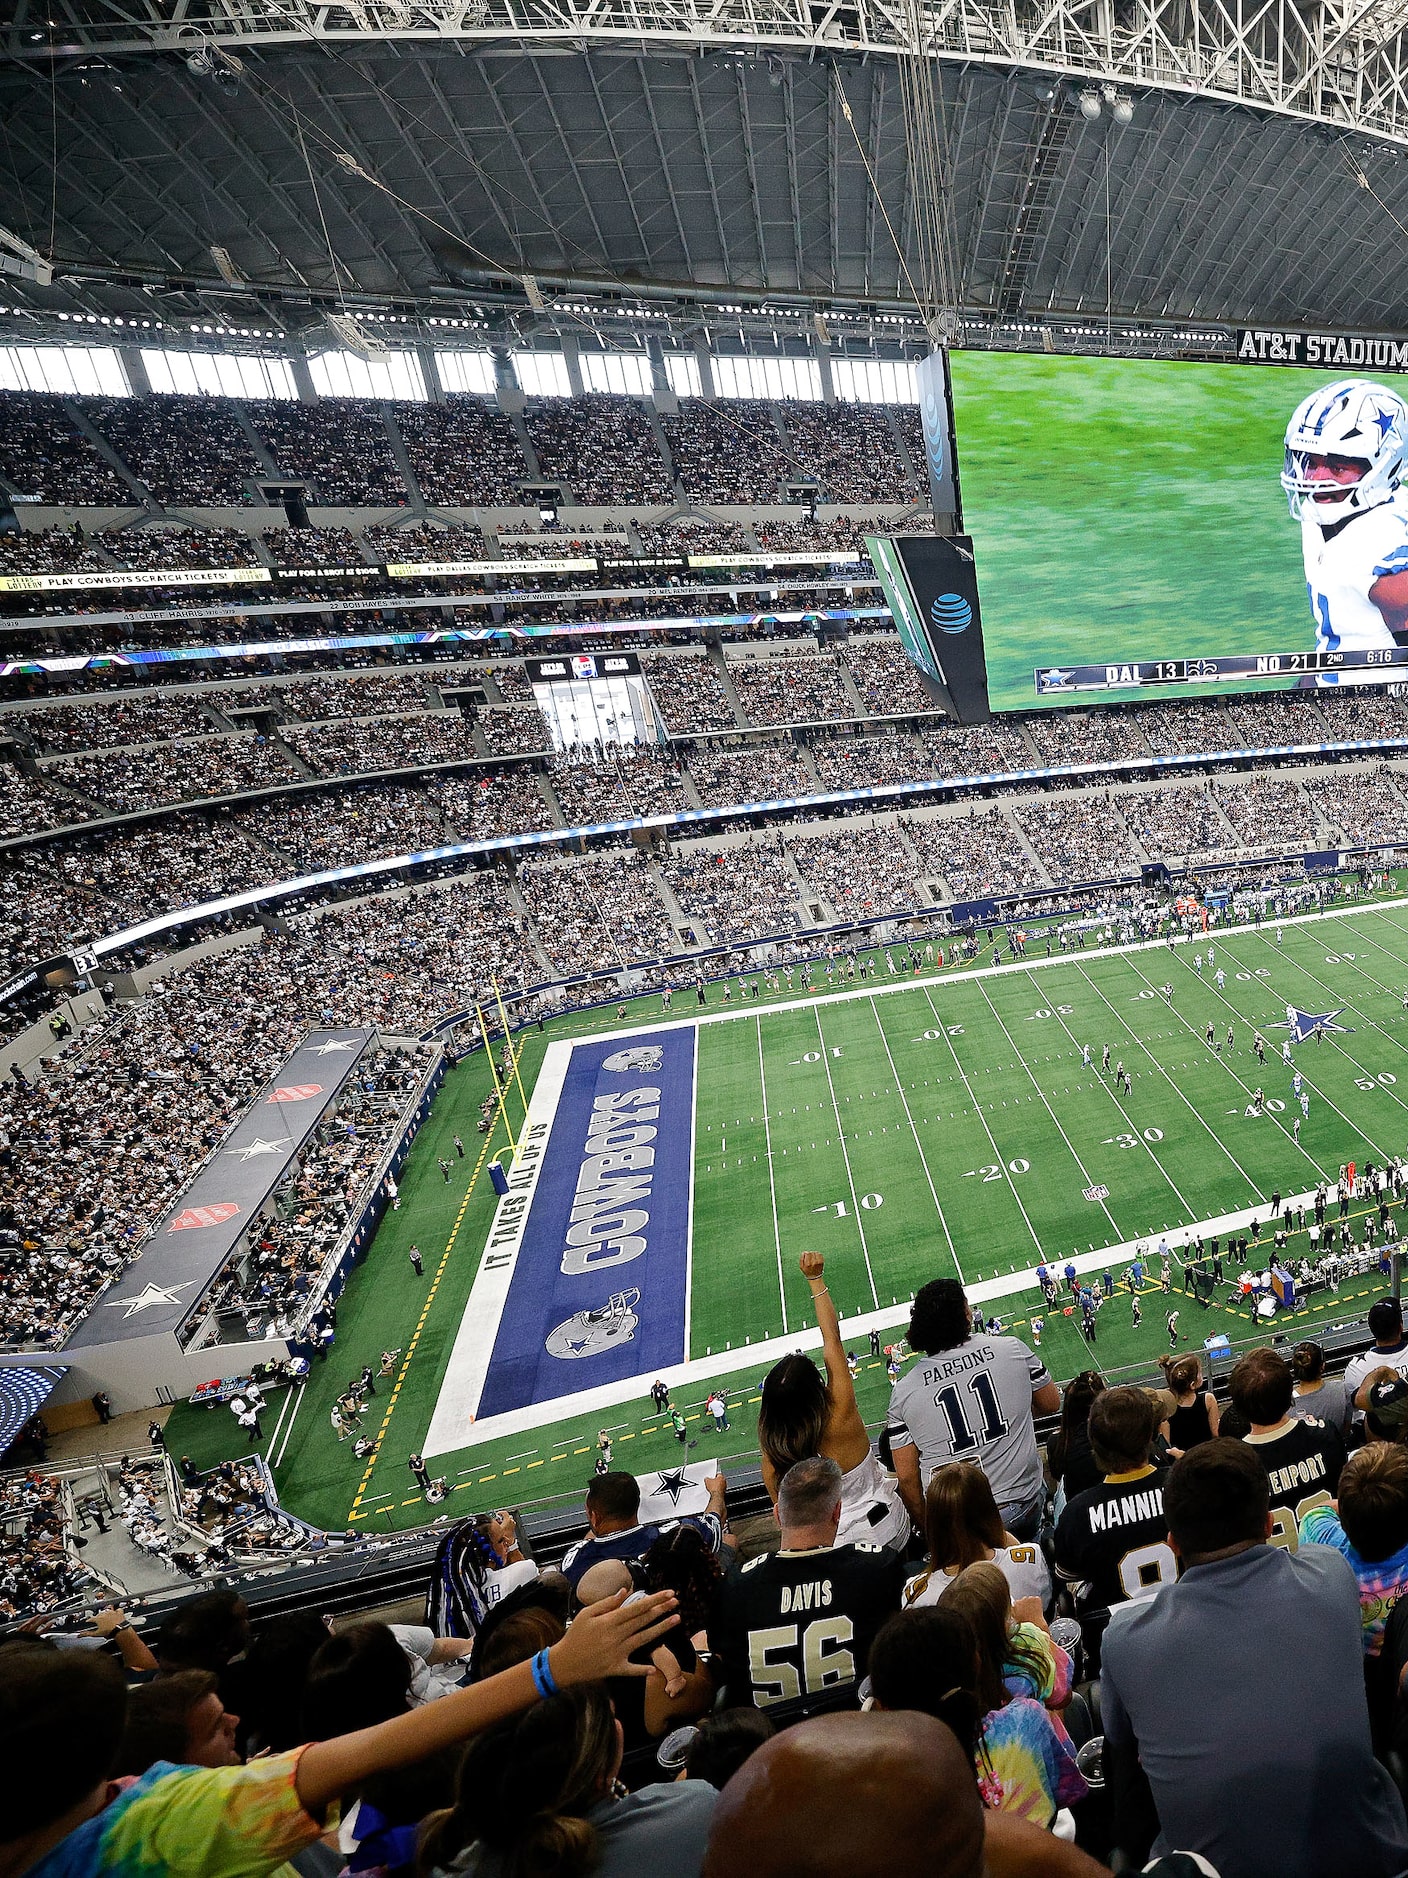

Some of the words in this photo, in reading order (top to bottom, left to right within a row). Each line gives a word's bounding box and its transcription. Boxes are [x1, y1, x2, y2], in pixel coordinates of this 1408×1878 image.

[1238, 330, 1301, 360] AT&T
[7, 582, 43, 591] LOTTERY
[48, 577, 74, 587] PLAY
[77, 576, 133, 585] COWBOYS
[136, 573, 182, 583] SCRATCH
[185, 572, 228, 582] TICKETS!
[278, 570, 298, 578] PLAY
[299, 569, 317, 577] FOR
[362, 600, 388, 608] HAYES
[532, 593, 556, 601] WHITE
[123, 613, 135, 621] 43
[138, 612, 166, 620] CLIFF
[168, 610, 204, 618] HARRIS
[1256, 656, 1281, 673] NO
[1290, 653, 1308, 671] 21
[1326, 652, 1345, 665] 2ND
[1366, 649, 1392, 663] 6:16
[1105, 664, 1143, 683] DAL
[1155, 662, 1177, 679] 13
[1353, 1071, 1398, 1091] 50
[1243, 1098, 1286, 1118] 40
[527, 1121, 548, 1141] US
[1114, 1127, 1164, 1149] 30
[510, 1157, 537, 1189] ALL
[559, 1086, 663, 1276] COWBOYS
[977, 1157, 1032, 1183] 20
[491, 1187, 528, 1248] TAKES
[830, 1192, 884, 1220] 10
[484, 1248, 513, 1272] IT
[922, 1345, 996, 1387] PARSONS
[933, 1369, 1009, 1455] 11
[1270, 1453, 1326, 1497] ENPORT
[1088, 1486, 1165, 1534] MANNIN
[780, 1580, 833, 1614] DAVIS
[747, 1615, 856, 1709] 56
